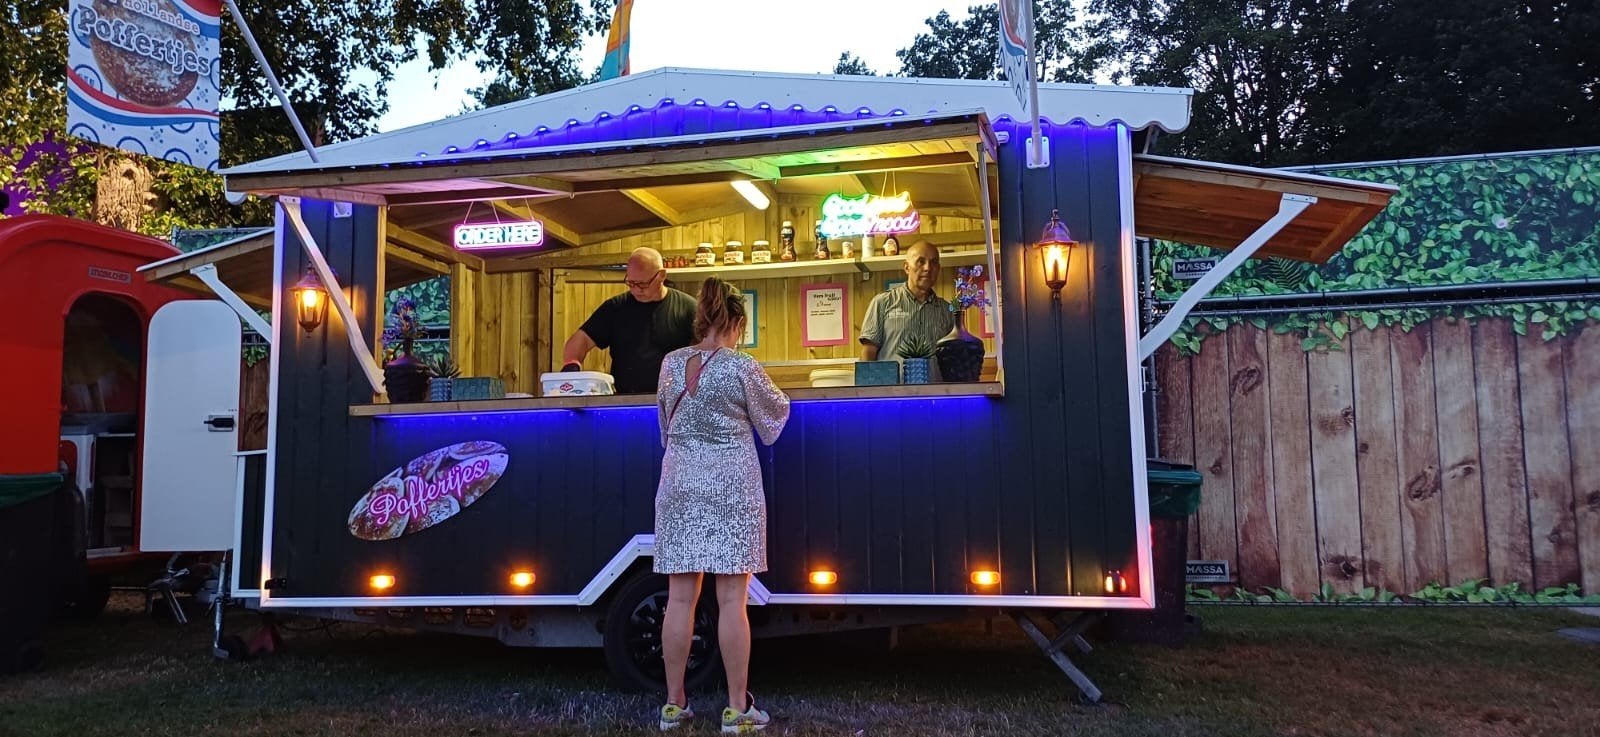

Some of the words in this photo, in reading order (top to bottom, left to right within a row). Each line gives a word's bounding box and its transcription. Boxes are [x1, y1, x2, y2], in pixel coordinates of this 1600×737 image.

[77, 3, 211, 75] Poffertjes
[458, 227, 503, 246] ORDER
[1177, 262, 1213, 272] MASSA
[369, 458, 490, 525] Poffertjes
[1186, 565, 1224, 574] MASSA
